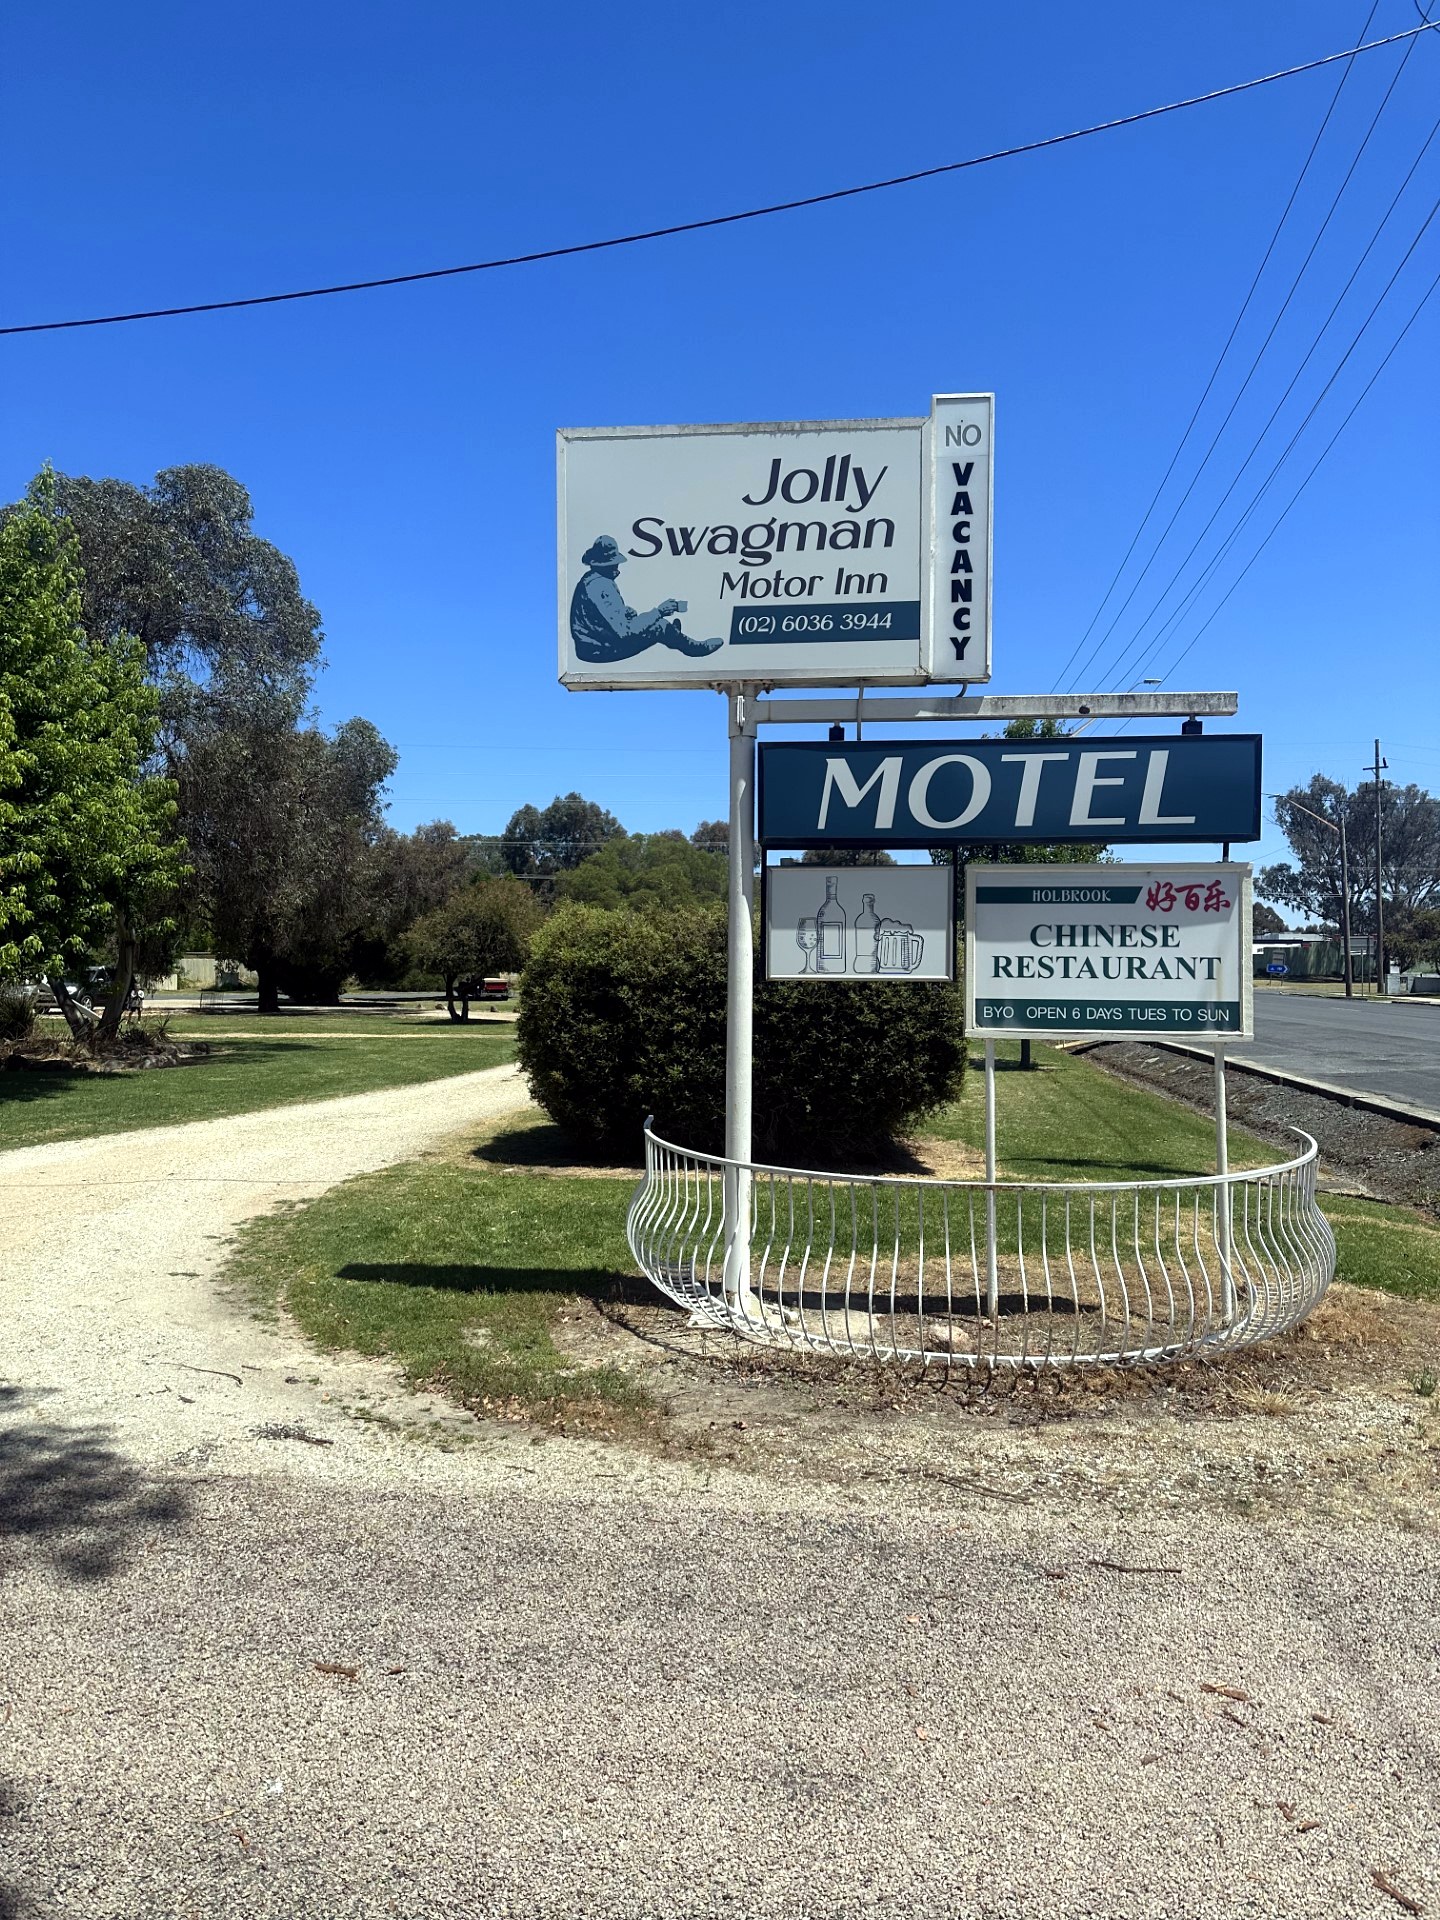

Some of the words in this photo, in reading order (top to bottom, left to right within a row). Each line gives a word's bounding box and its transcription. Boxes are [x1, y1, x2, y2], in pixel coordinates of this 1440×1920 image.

[946, 424, 982, 448] NO
[741, 453, 889, 513] Jolly
[628, 516, 895, 567] Swagman
[950, 462, 975, 661] VACANCY
[719, 571, 823, 600] Motor
[835, 567, 888, 595] Inn
[738, 613, 776, 635] (02)
[781, 614, 834, 633] 6036
[840, 612, 893, 631] 3944
[817, 750, 1196, 830] MOTEL
[1032, 888, 1112, 903] HOLBROOK
[1030, 923, 1181, 948] CHINESE
[991, 955, 1222, 981] RESTAURANT
[983, 1006, 1015, 1019] BYO
[1026, 1006, 1067, 1020] OPEN
[1072, 1006, 1081, 1020] 6
[1086, 1006, 1122, 1020] DAYS
[1127, 1007, 1168, 1021] TUES
[1172, 1008, 1192, 1021] TO
[1198, 1008, 1230, 1022] SUN
